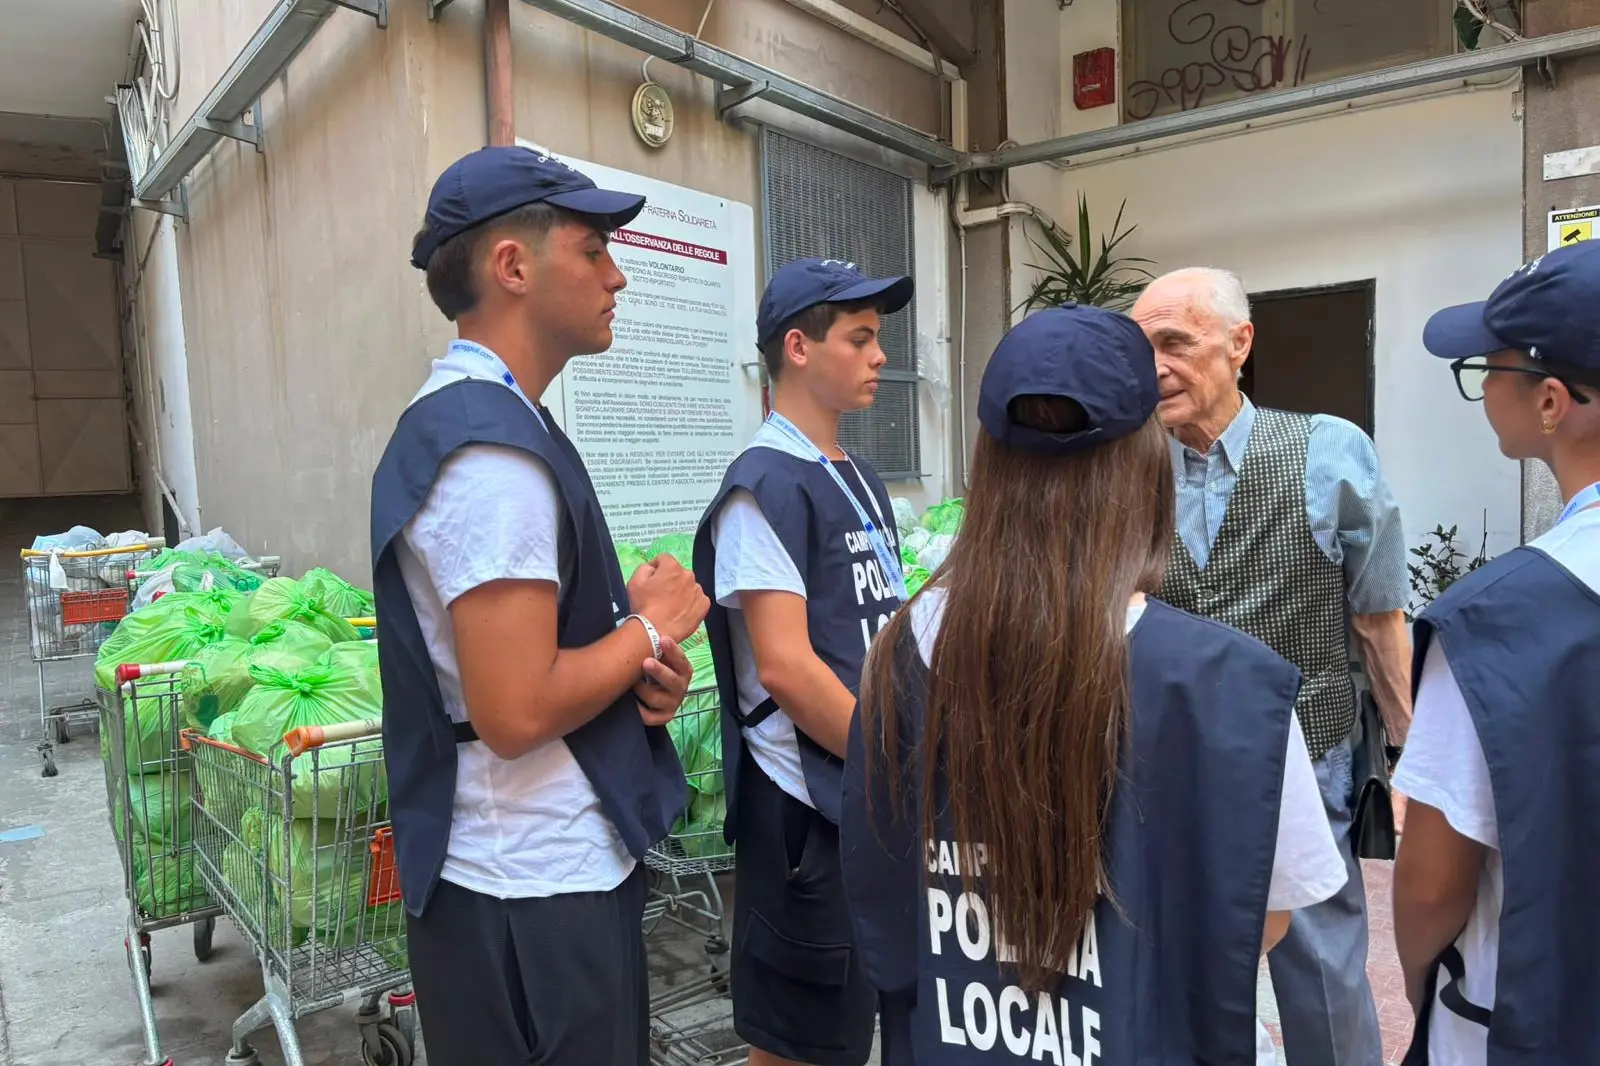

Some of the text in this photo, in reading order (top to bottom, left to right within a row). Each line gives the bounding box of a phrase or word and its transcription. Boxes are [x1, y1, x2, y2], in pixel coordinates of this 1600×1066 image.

[1554, 210, 1598, 221] ATTENZIONE!
[609, 231, 720, 261] ALL'OSSERVANZA DELLE REGOLE
[648, 261, 684, 274] VOLONTARIO
